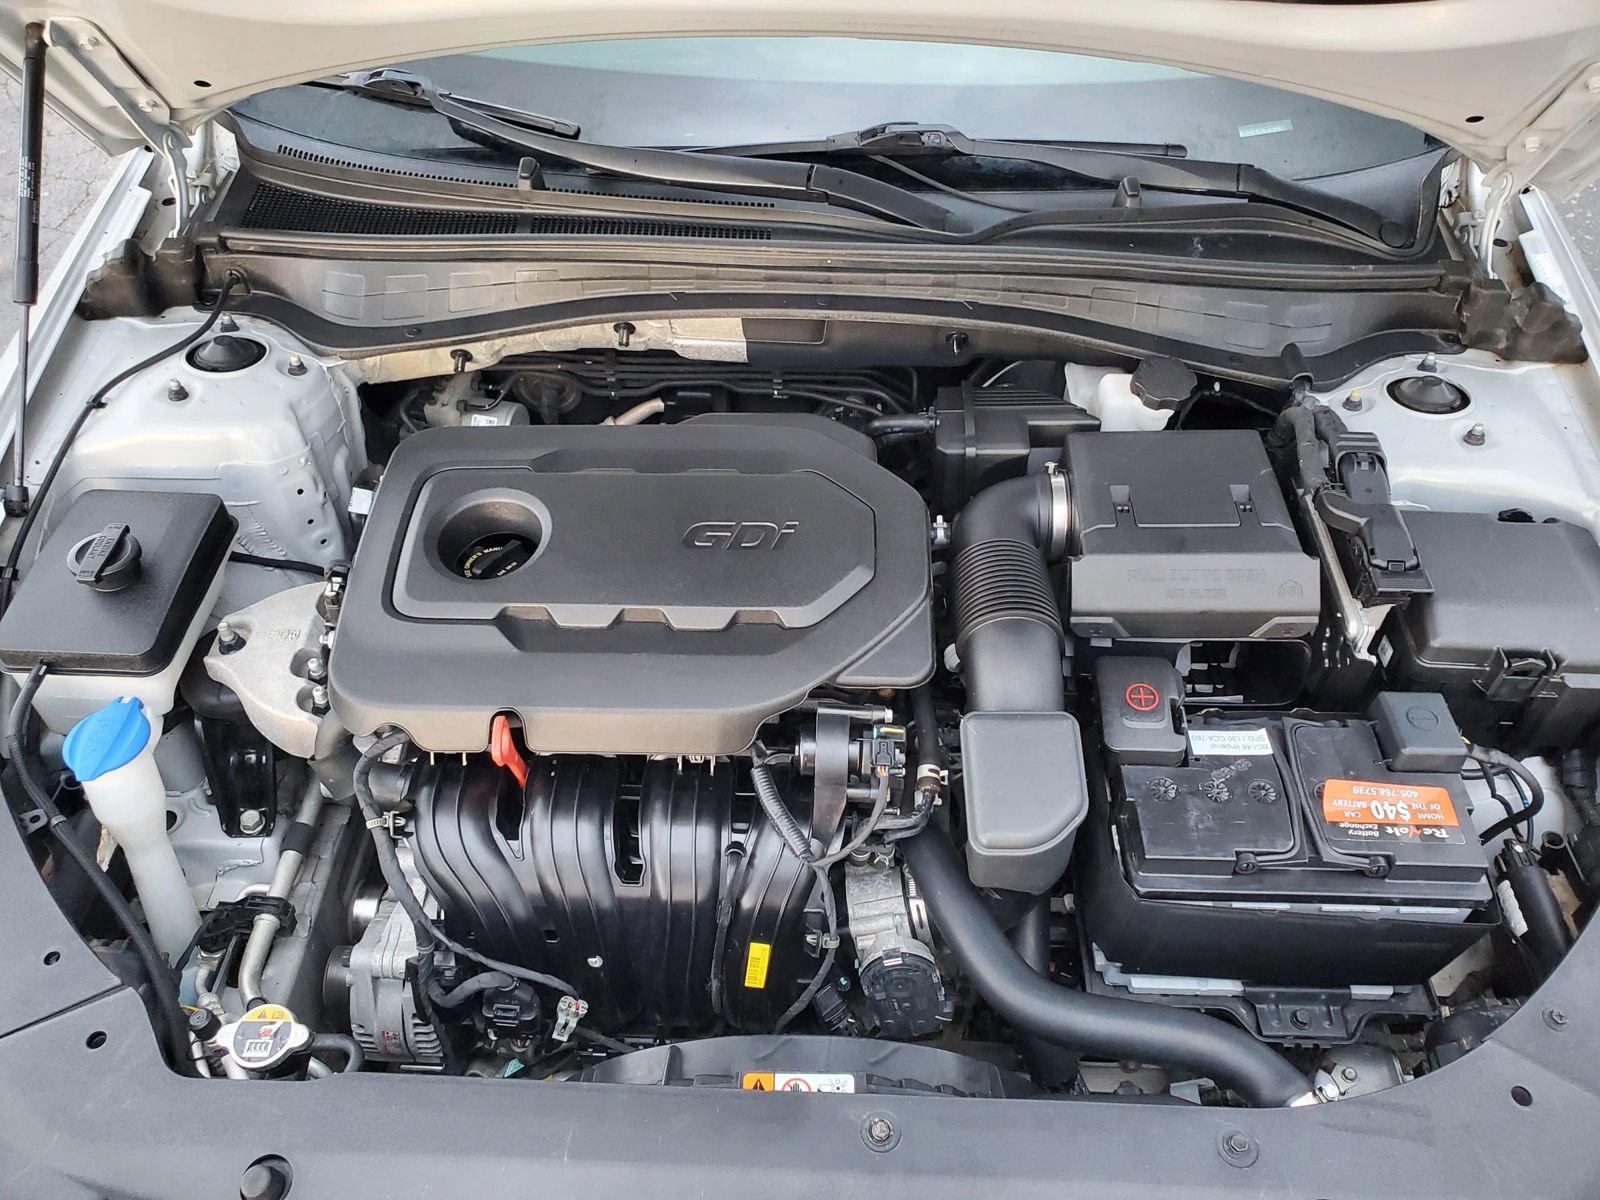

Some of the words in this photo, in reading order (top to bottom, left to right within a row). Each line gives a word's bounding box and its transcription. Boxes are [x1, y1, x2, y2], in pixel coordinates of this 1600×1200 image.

[86, 535, 107, 560] COOLANT
[97, 537, 115, 558] ENGINE
[1352, 785, 1420, 798] 405.768.5739
[1332, 799, 1368, 809] BATTERY
[1411, 802, 1427, 810] THE
[1430, 803, 1441, 811] OF
[1343, 810, 1361, 819] CAR
[1370, 799, 1412, 822] $40
[1416, 812, 1445, 820] HOME
[1338, 821, 1378, 831] Exchange
[1348, 829, 1380, 838] Battery
